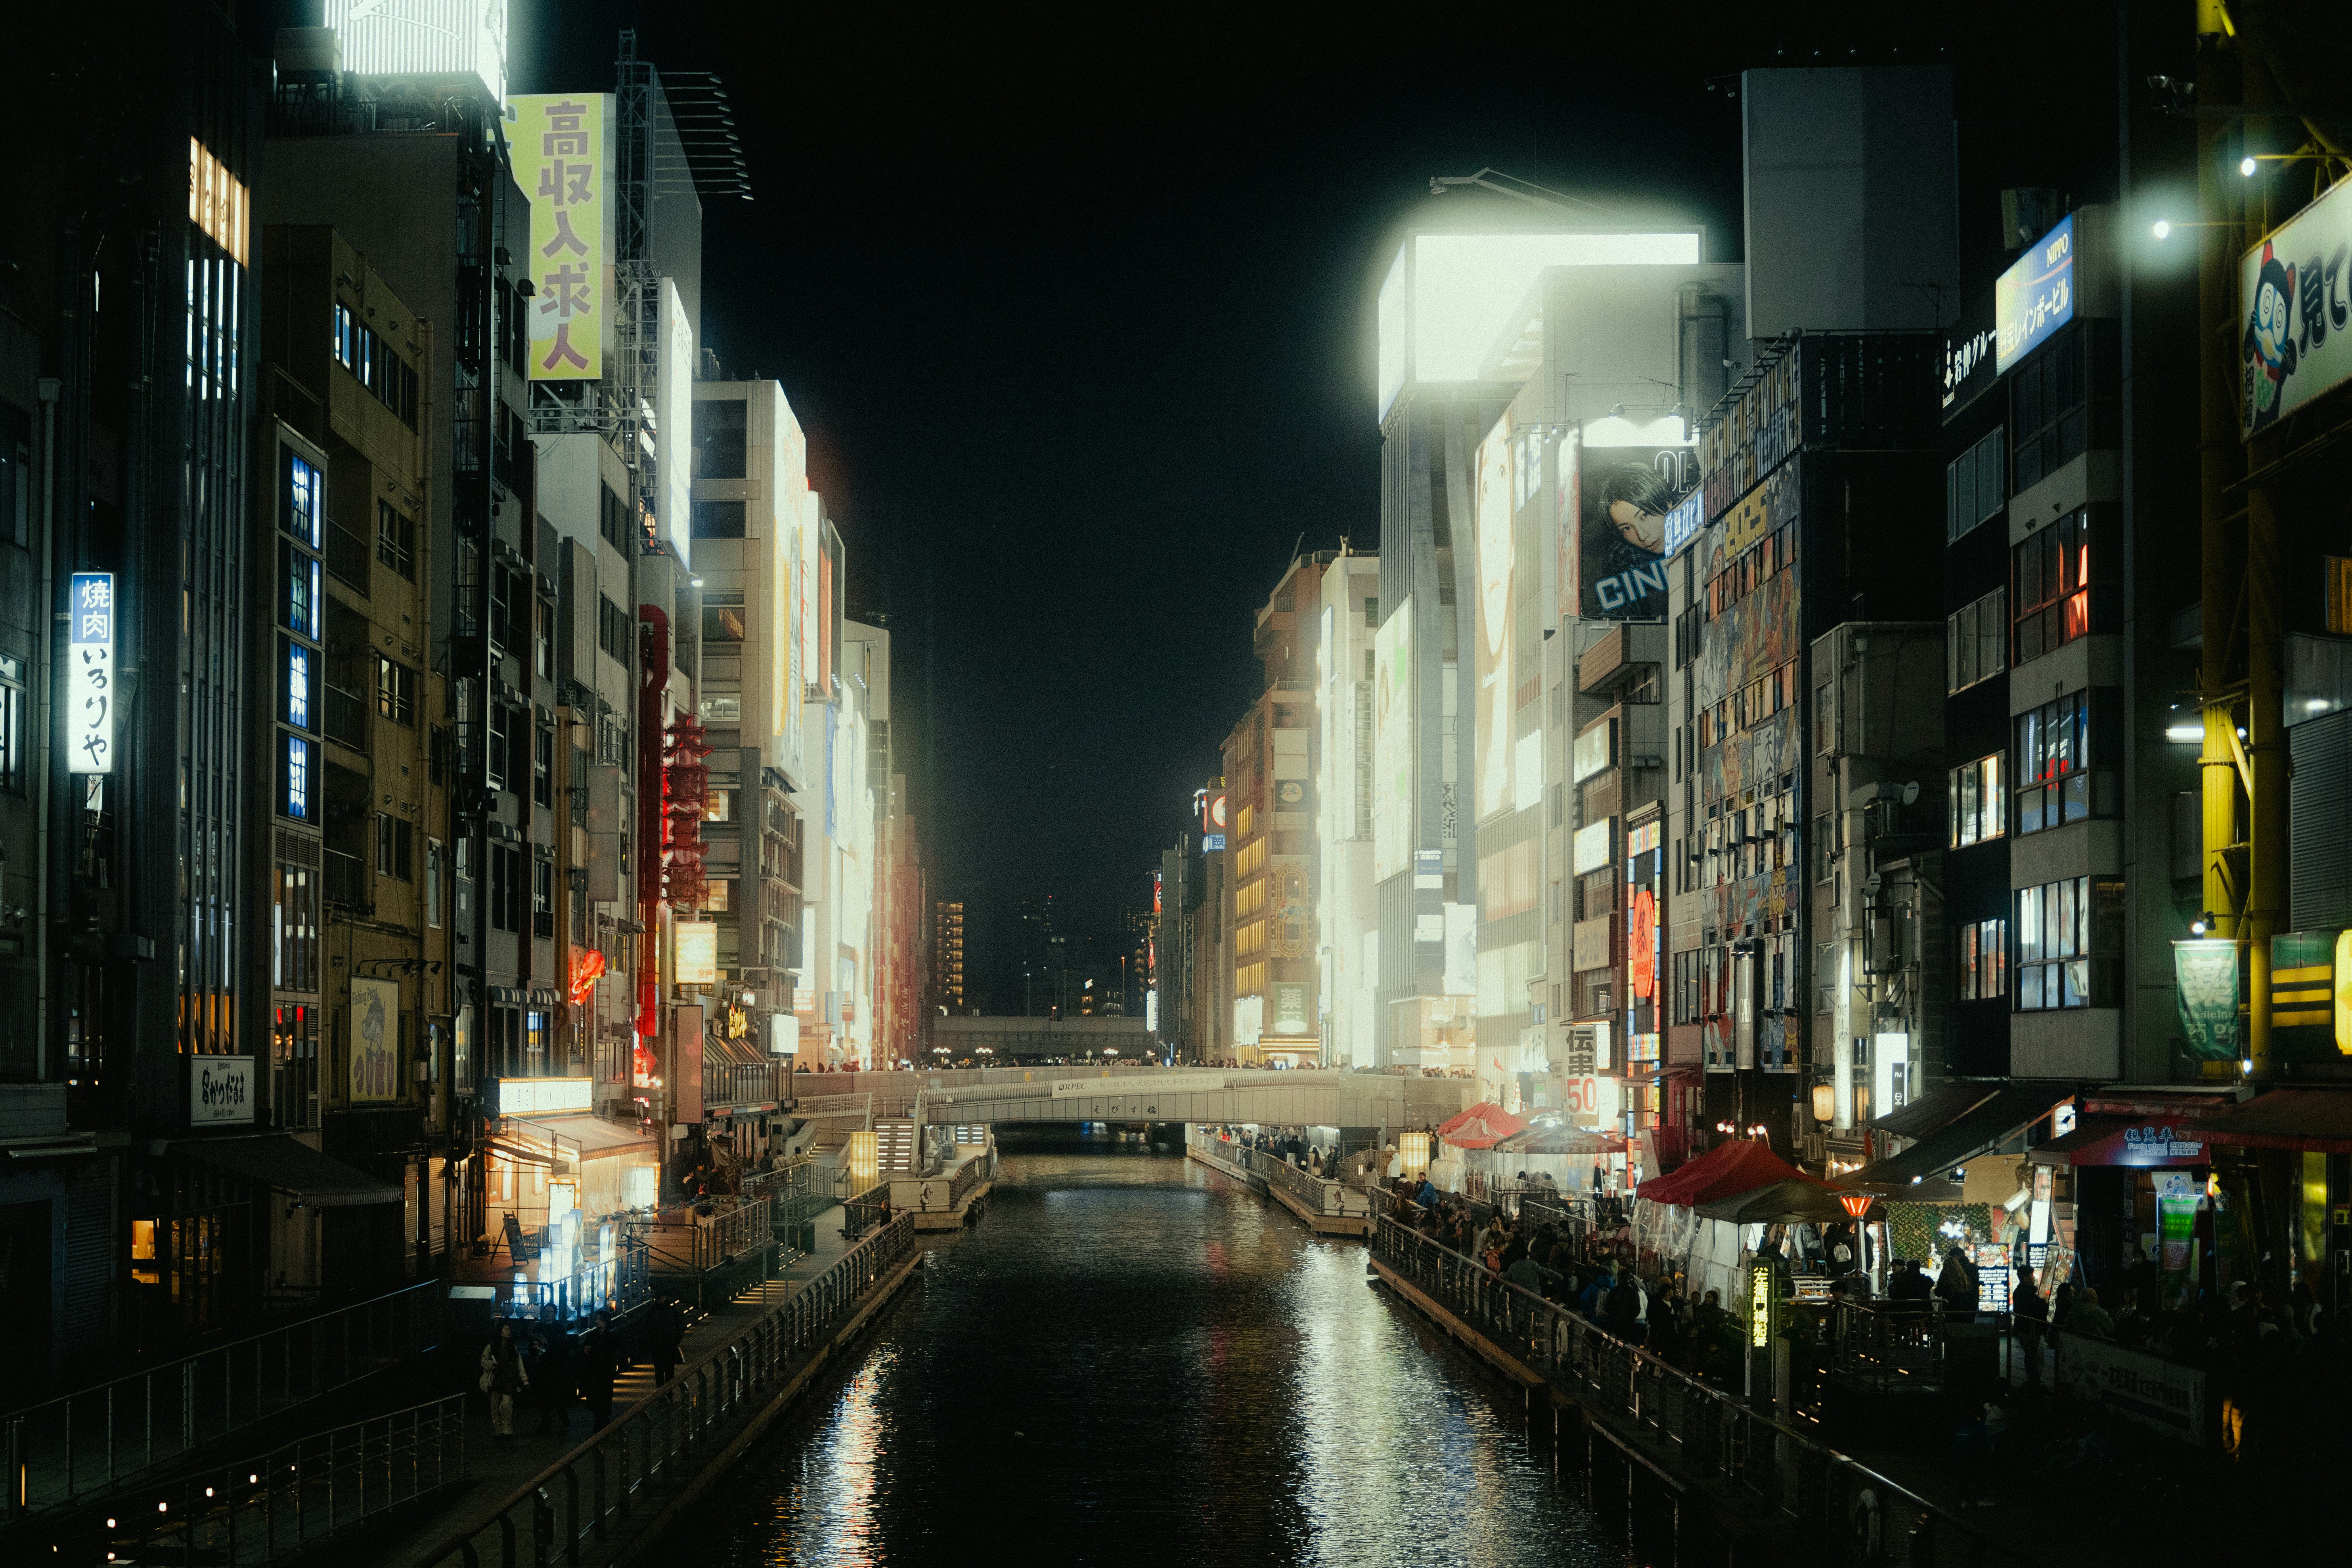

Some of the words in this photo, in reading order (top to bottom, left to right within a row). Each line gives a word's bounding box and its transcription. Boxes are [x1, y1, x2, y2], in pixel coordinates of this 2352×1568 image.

[538, 101, 593, 370] 高収入求人
[2047, 233, 2069, 267] NIPPO
[2299, 241, 2352, 358] 見て
[1726, 482, 1767, 561] 2025
[1596, 559, 1669, 611] CIN
[82, 580, 110, 639] 焼肉
[83, 648, 107, 766] いろりや
[698, 969, 713, 978] 2F
[2182, 958, 2233, 1007] 薬
[1281, 988, 1302, 1009] 薬
[1566, 1030, 1594, 1077] 伝串
[202, 1066, 245, 1112] 串かつだるま
[1094, 1105, 1157, 1114] えびす橋
[1567, 1078, 1597, 1113] 50
[2124, 1126, 2176, 1142] 観覧車
